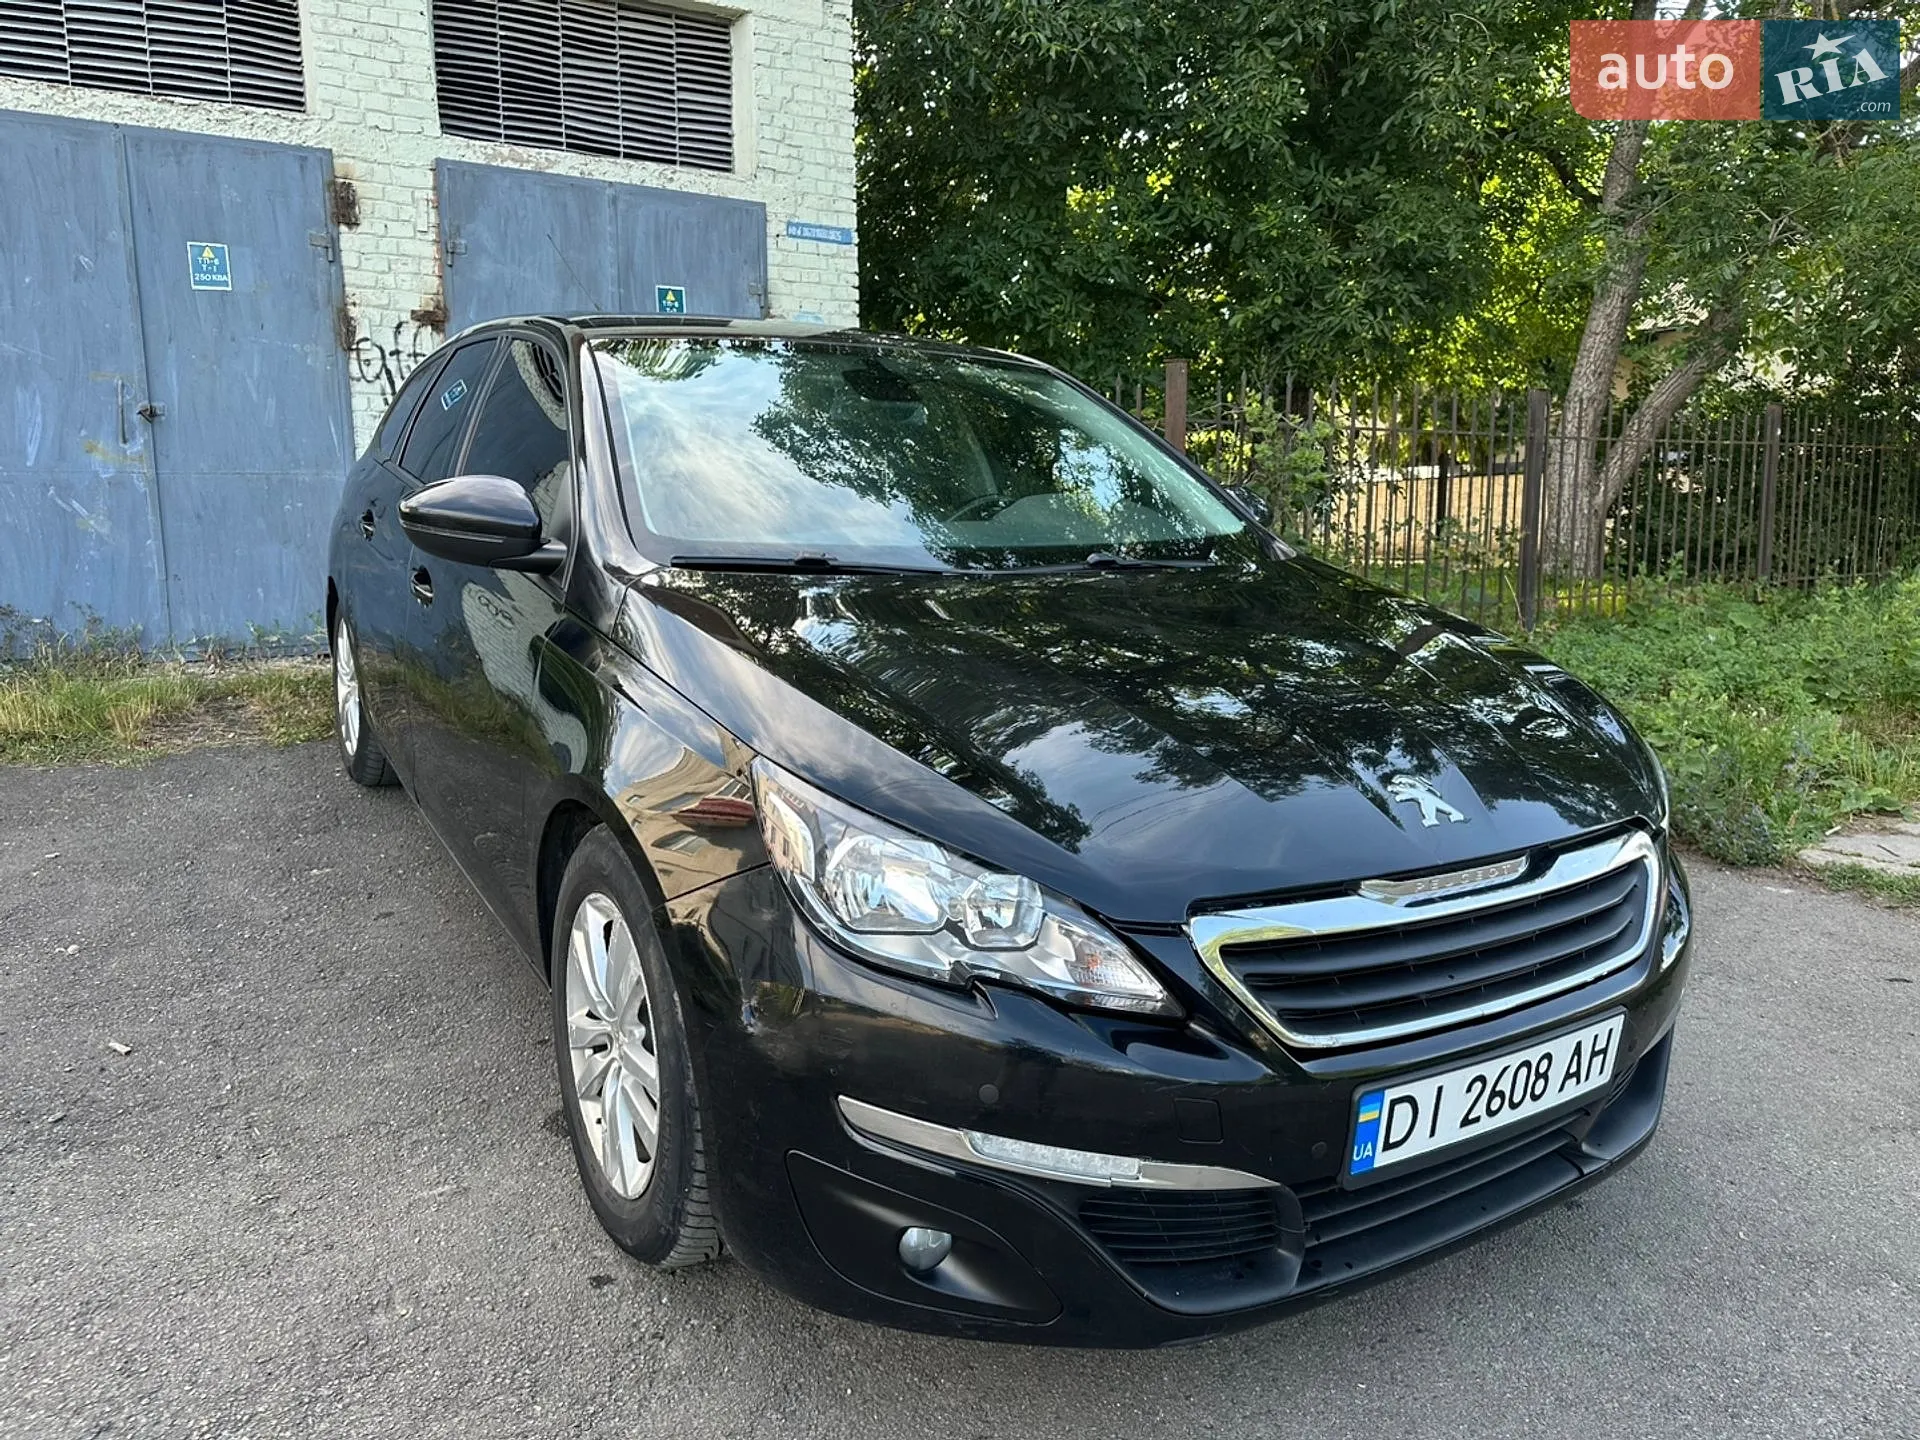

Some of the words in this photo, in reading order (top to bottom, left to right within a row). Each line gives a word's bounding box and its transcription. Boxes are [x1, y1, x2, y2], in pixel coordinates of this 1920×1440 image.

[194, 273, 212, 281] 250
[1382, 1085, 1444, 1152] DI
[1459, 1052, 1553, 1129] 2608
[1558, 1027, 1614, 1093] AH
[1353, 1141, 1373, 1161] UA
